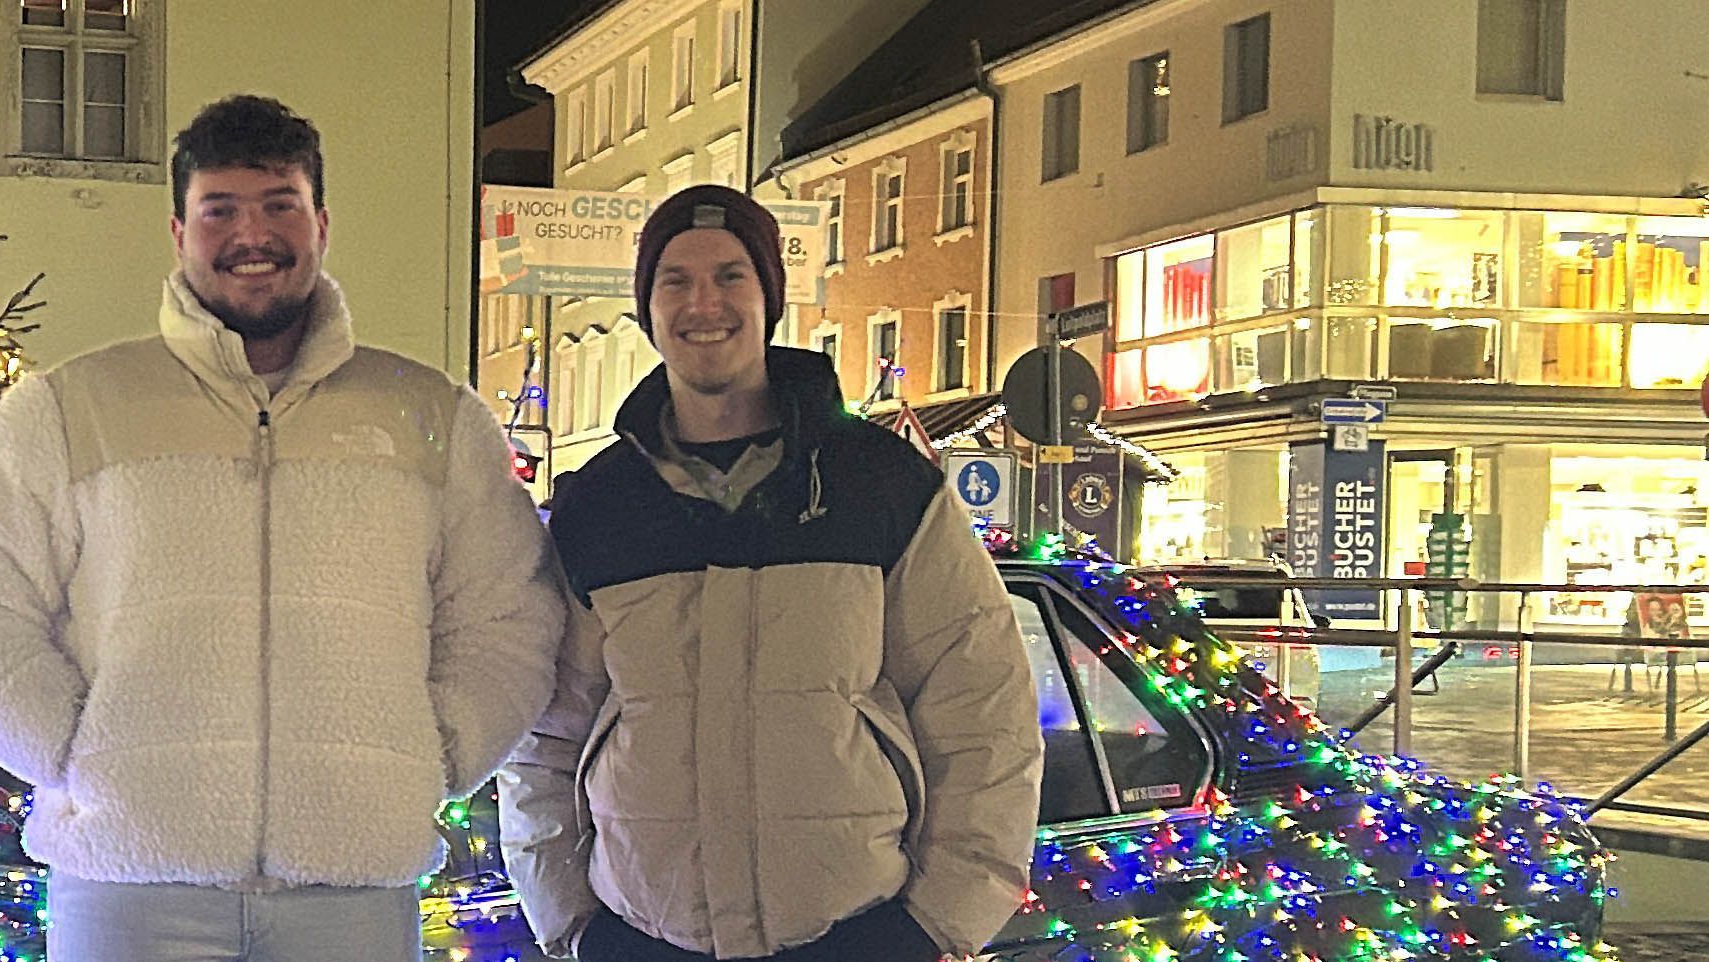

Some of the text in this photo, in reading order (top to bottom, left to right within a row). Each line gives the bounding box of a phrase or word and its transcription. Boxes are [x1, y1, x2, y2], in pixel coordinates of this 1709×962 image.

[516, 201, 566, 217] NOCH
[535, 223, 623, 241] GESUCHT?
[1330, 481, 1355, 578] BÜCHER
[1354, 480, 1376, 578] PUSTET
